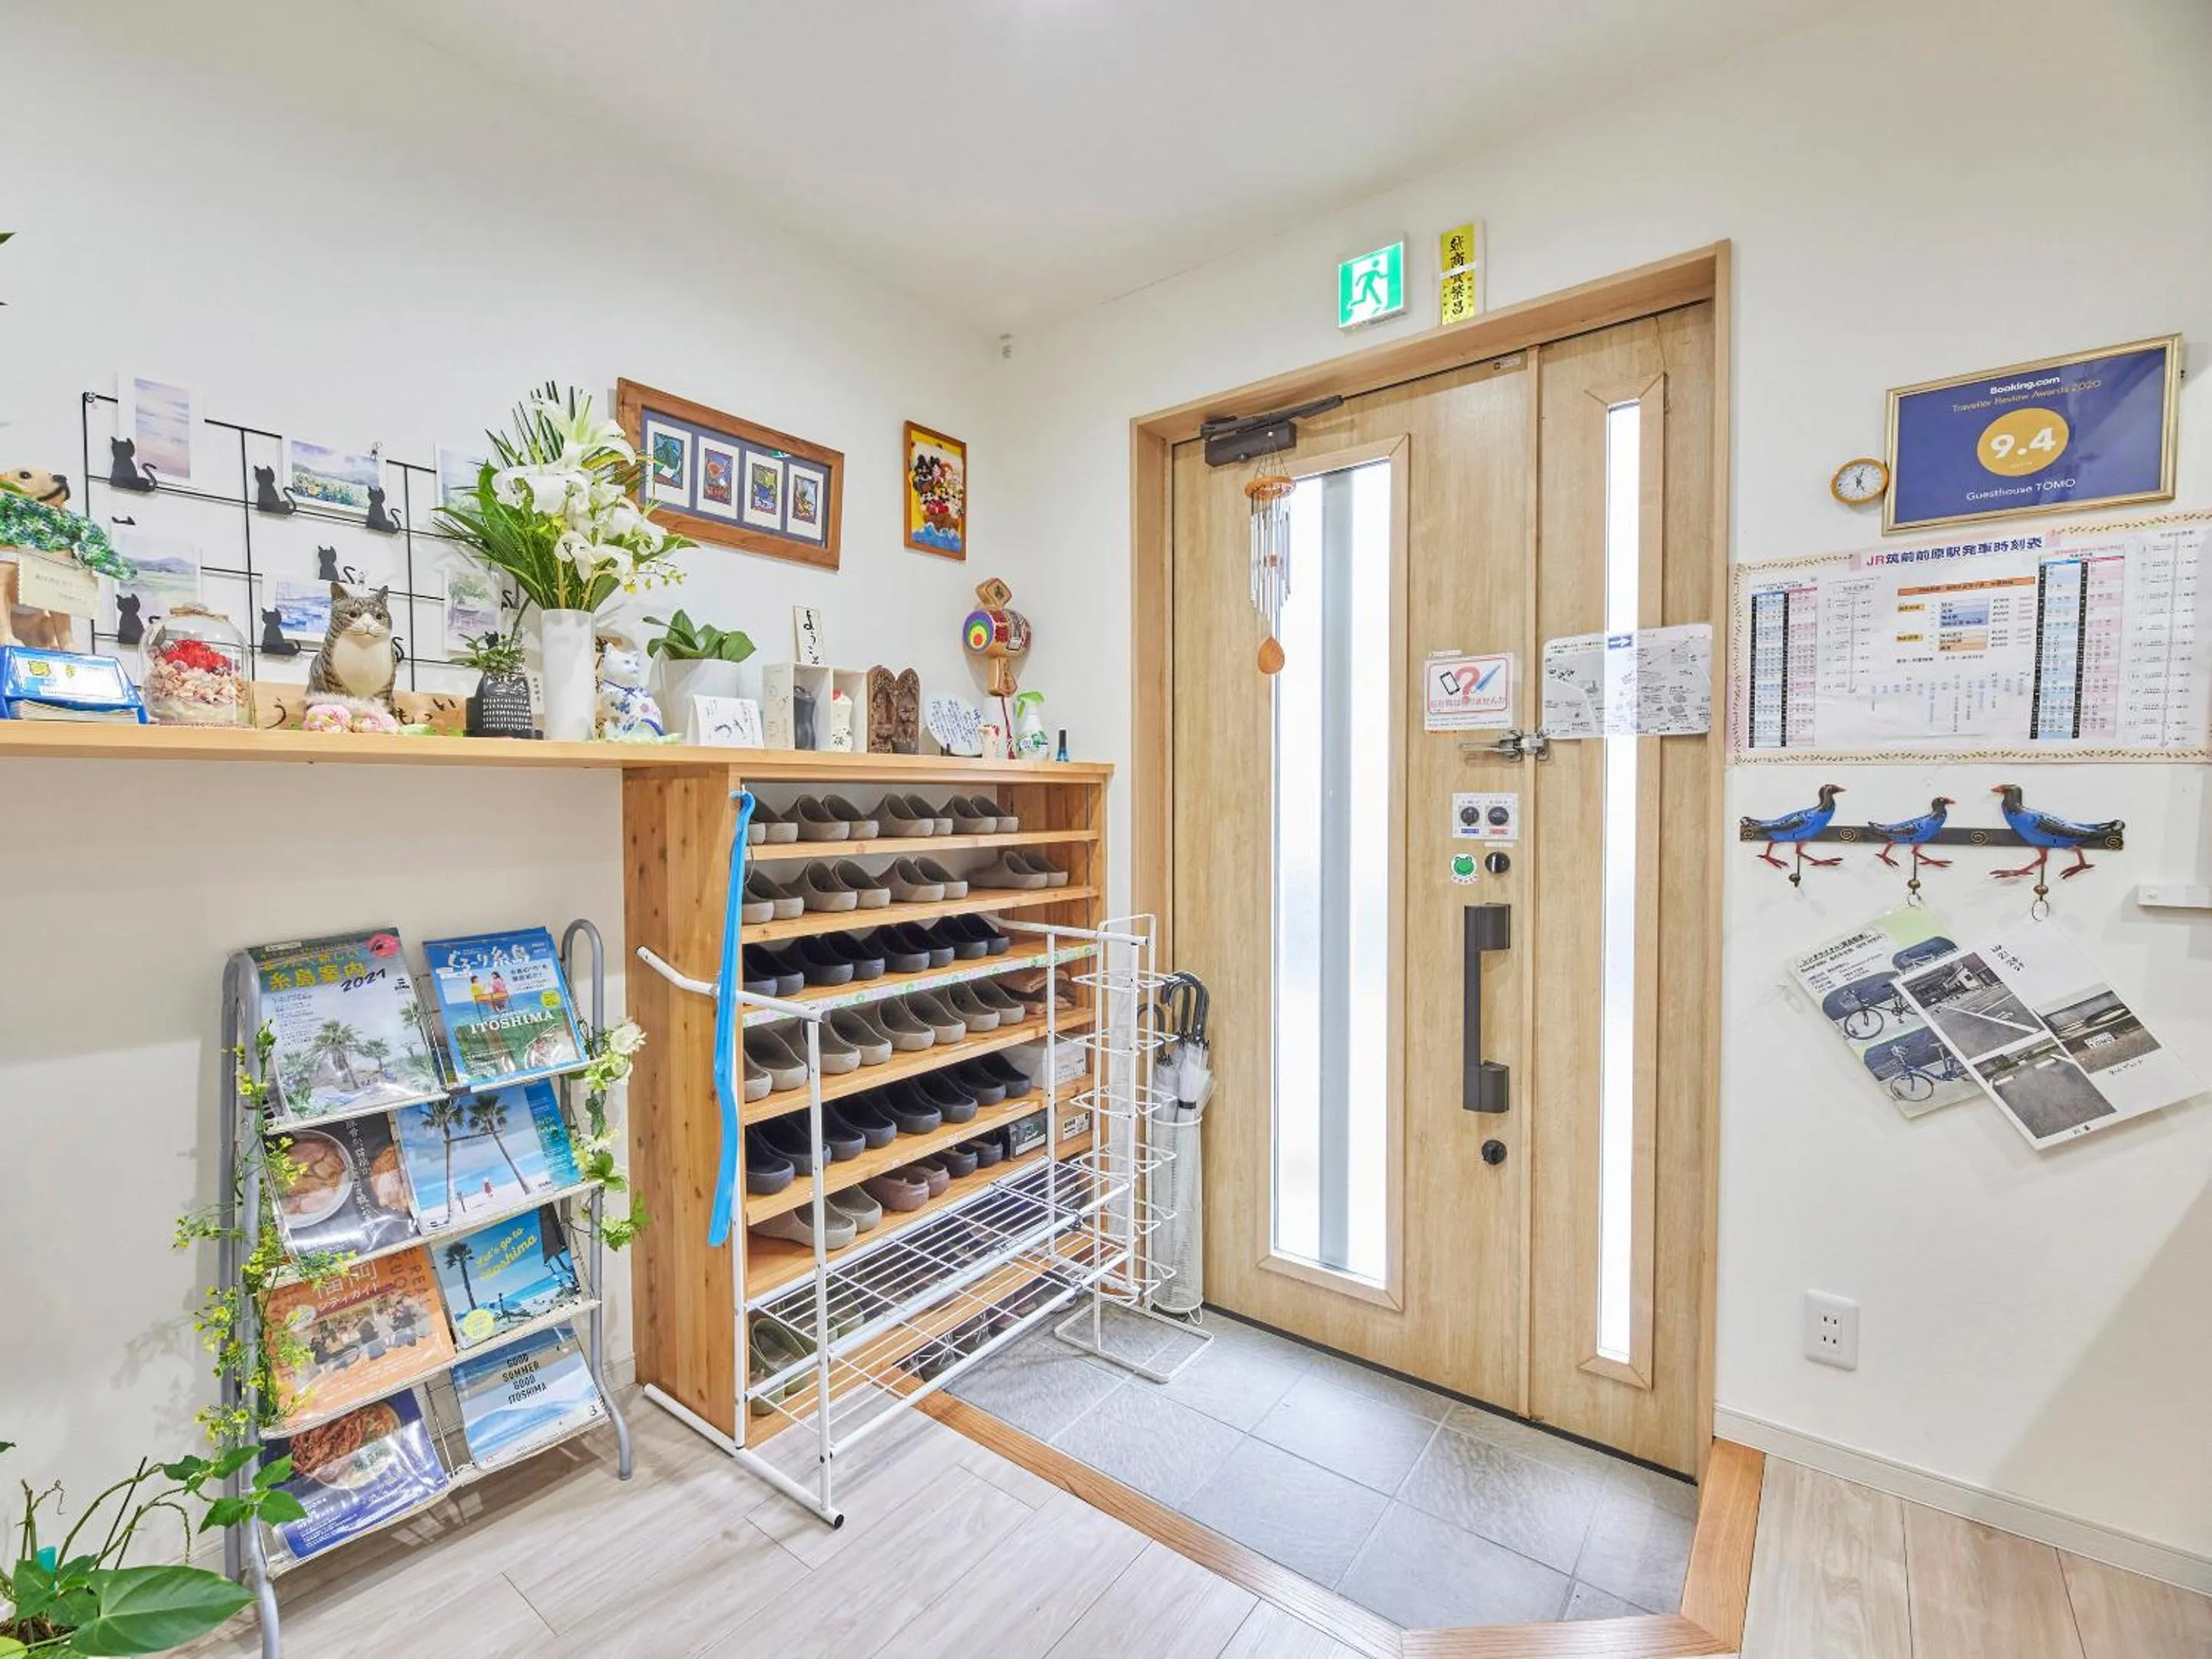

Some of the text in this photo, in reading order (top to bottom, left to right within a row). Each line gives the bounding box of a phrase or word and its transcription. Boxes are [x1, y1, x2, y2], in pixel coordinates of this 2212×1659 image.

[1952, 379, 2101, 412] Traveller Review Awards 2020
[1990, 376, 2060, 395] Booking.com
[1990, 427, 2056, 459] 9.4
[1966, 478, 2076, 501] Guesthouse TOMO
[1866, 536, 2042, 566] JR筑前前原駅発車時刻表
[268, 961, 369, 992] 糸島案内
[341, 968, 386, 992] 2021
[470, 1010, 555, 1035] ITOSHIMA
[499, 1237, 512, 1250] go
[512, 1227, 525, 1239] to
[502, 1360, 541, 1382] SUMMER
[506, 1353, 529, 1366] GOOD
[508, 1382, 548, 1405] ITOSHIMA
[512, 1375, 536, 1389] GOOD
